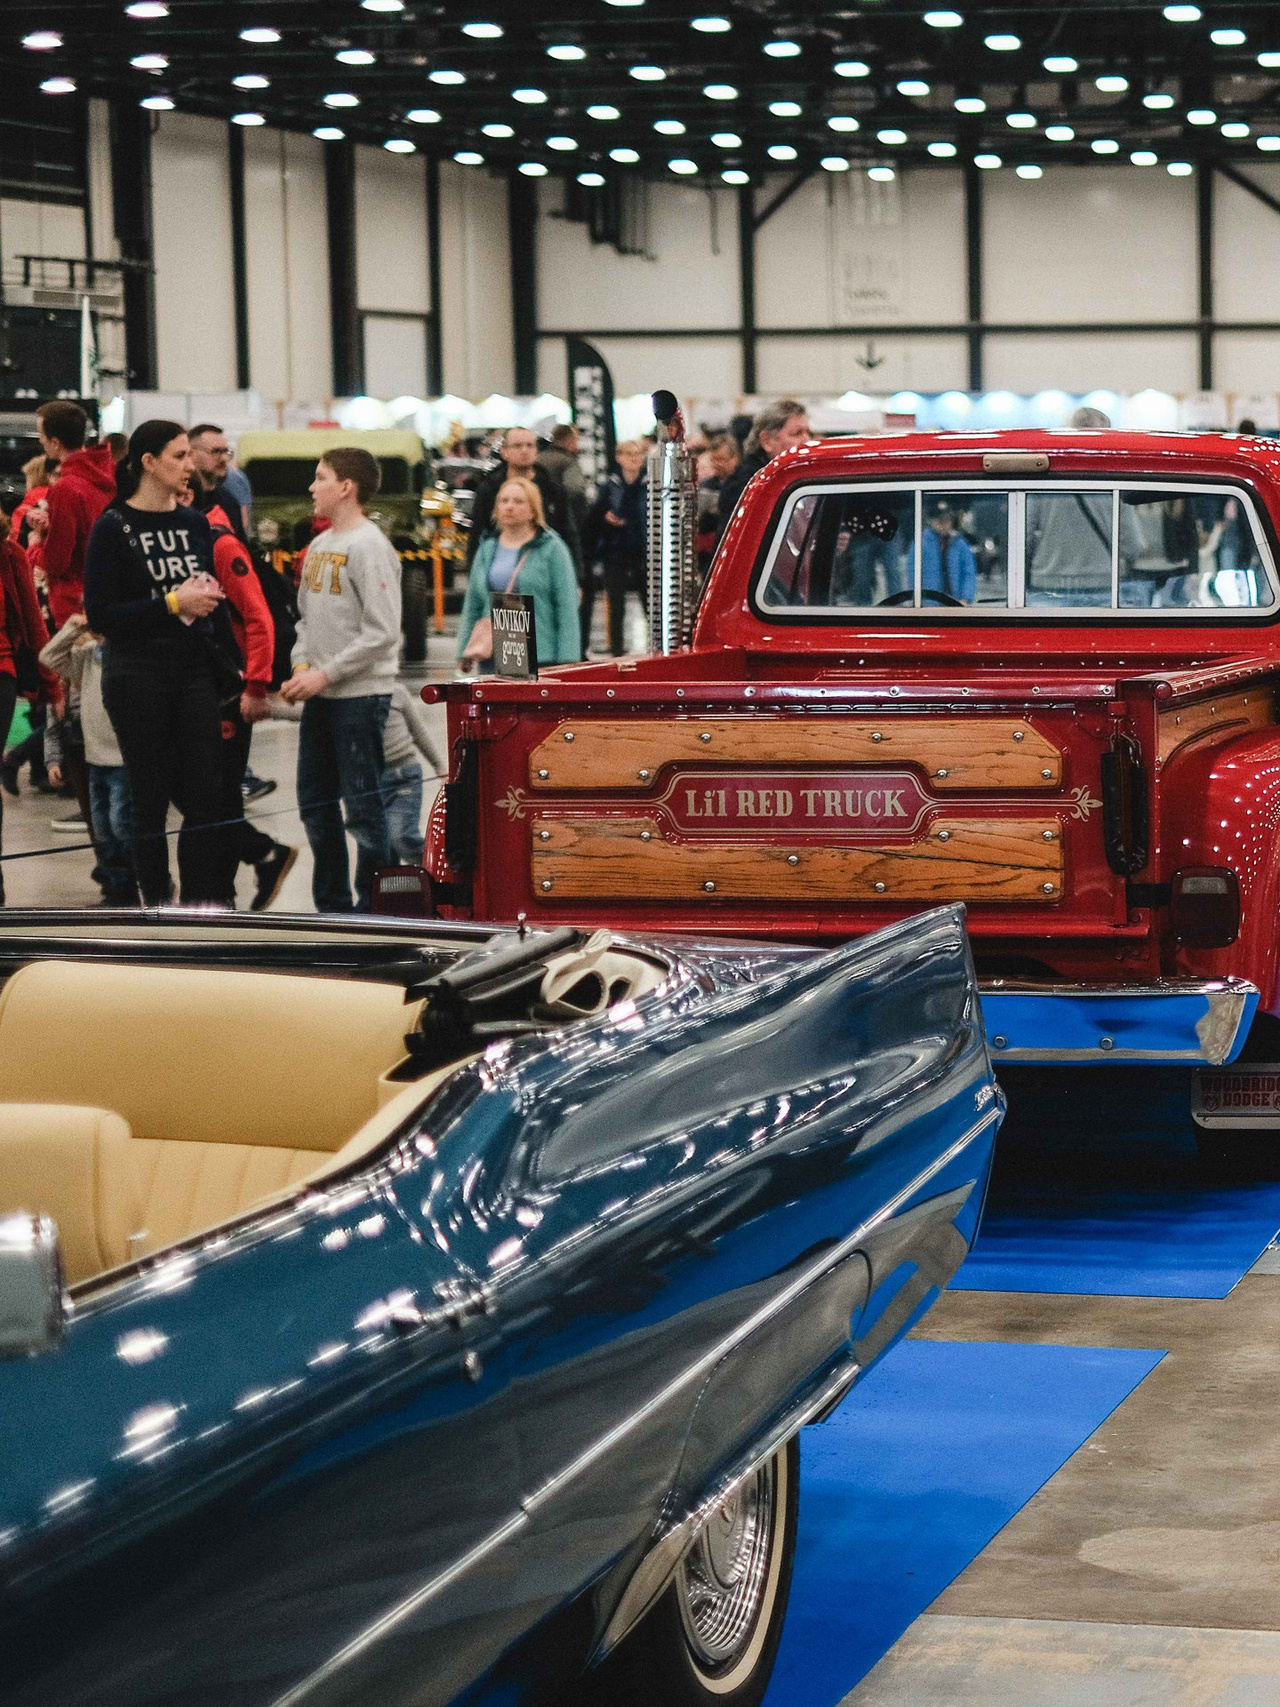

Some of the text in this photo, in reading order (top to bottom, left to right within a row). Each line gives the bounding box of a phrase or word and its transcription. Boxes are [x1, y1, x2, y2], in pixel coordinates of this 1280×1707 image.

[139, 529, 189, 555] FUT
[146, 555, 200, 581] URE
[492, 607, 531, 633] NOVIKOV
[736, 789, 793, 817] RED
[800, 789, 908, 817] TRUCK
[1222, 1092, 1270, 1107] DODGE
